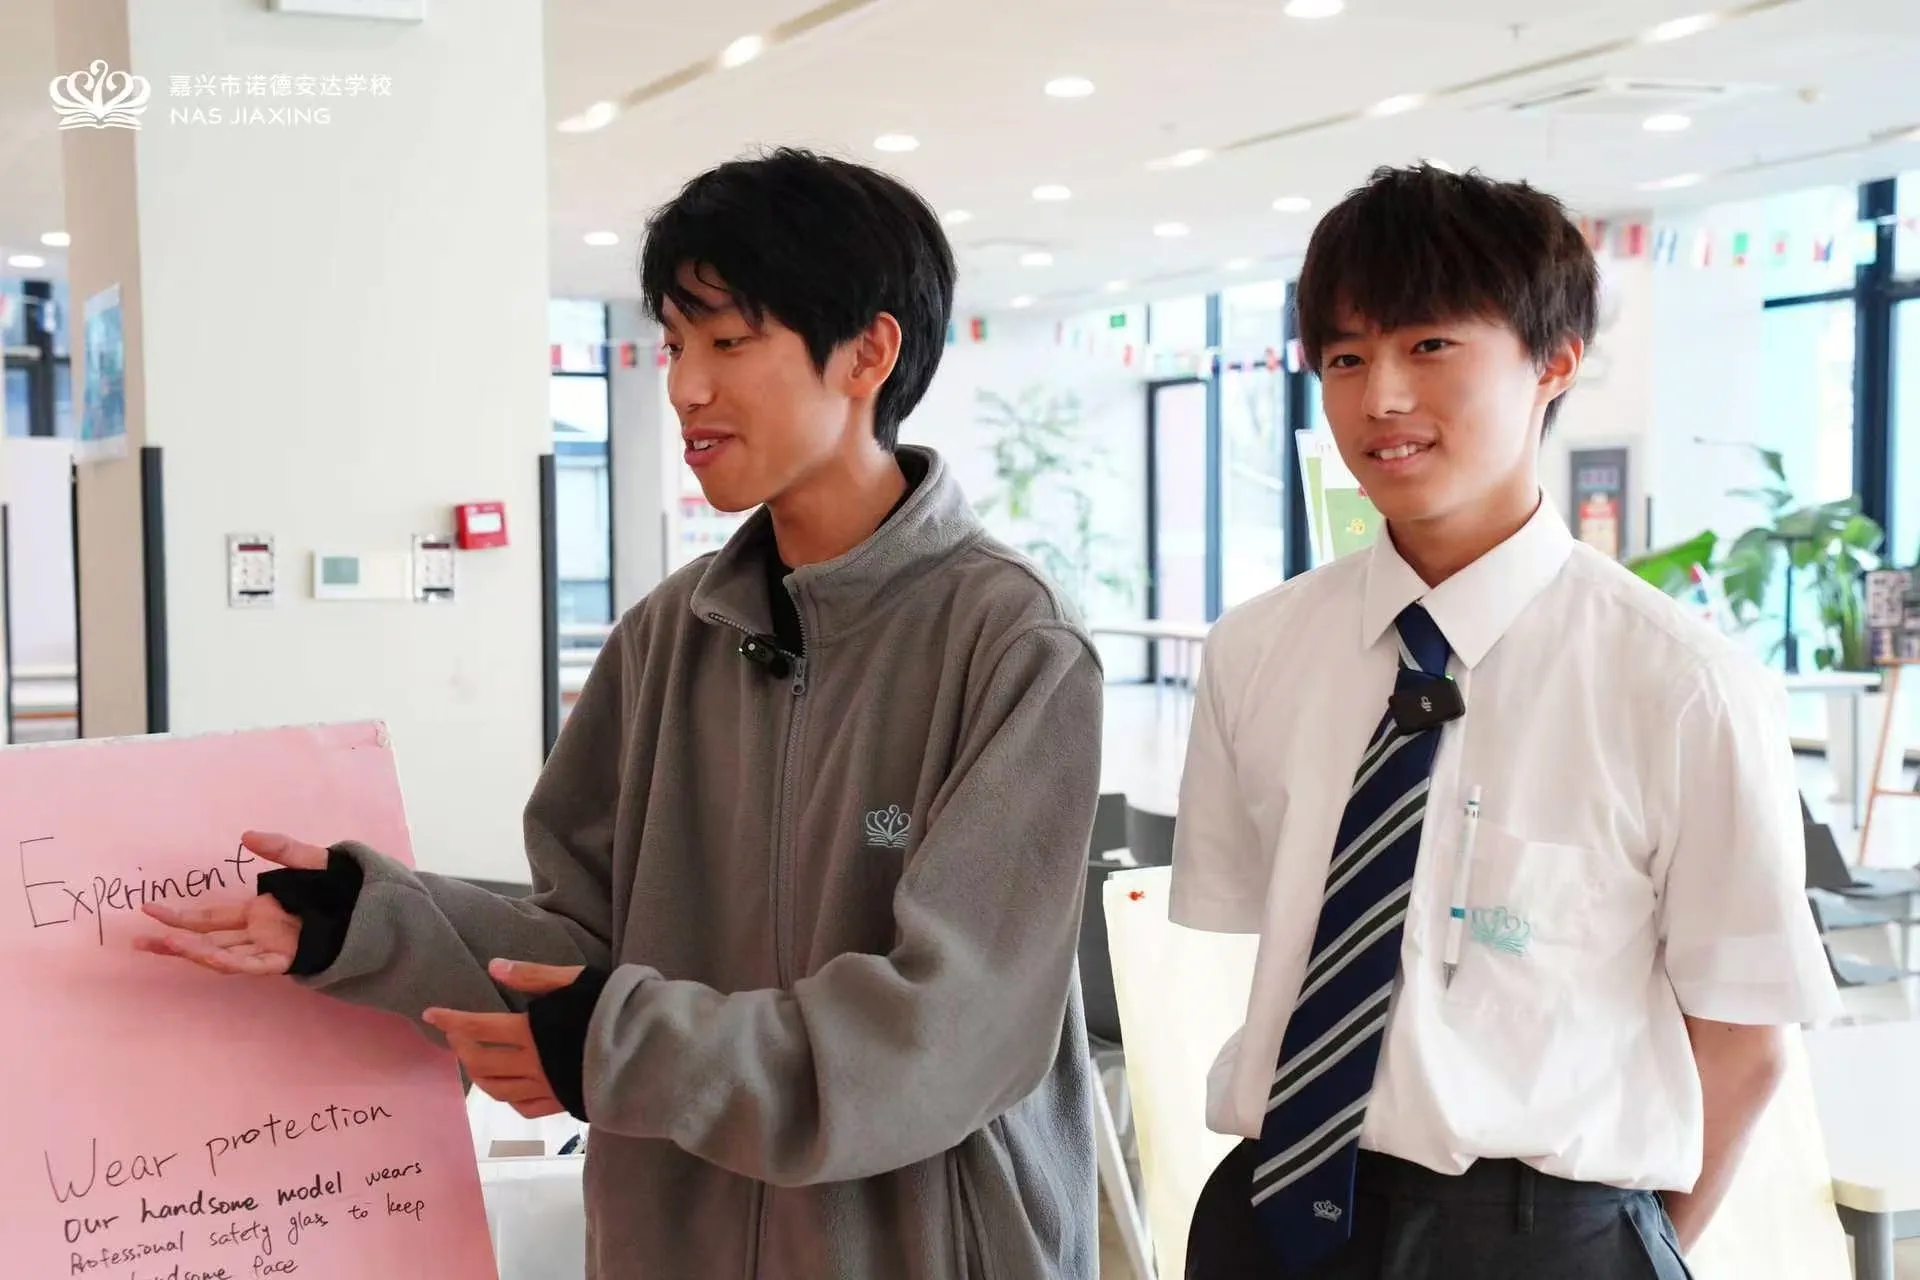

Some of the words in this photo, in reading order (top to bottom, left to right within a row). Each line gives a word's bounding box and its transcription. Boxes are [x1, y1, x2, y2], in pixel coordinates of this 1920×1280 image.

[19, 835, 255, 946] Experiment
[44, 1137, 178, 1204] Wear
[206, 1103, 393, 1177] protection
[140, 1189, 259, 1223] handsome
[277, 1170, 343, 1207] model
[365, 1161, 423, 1187] wears
[209, 1219, 273, 1256] safety
[347, 1204, 369, 1220] to
[386, 1192, 425, 1222] keep
